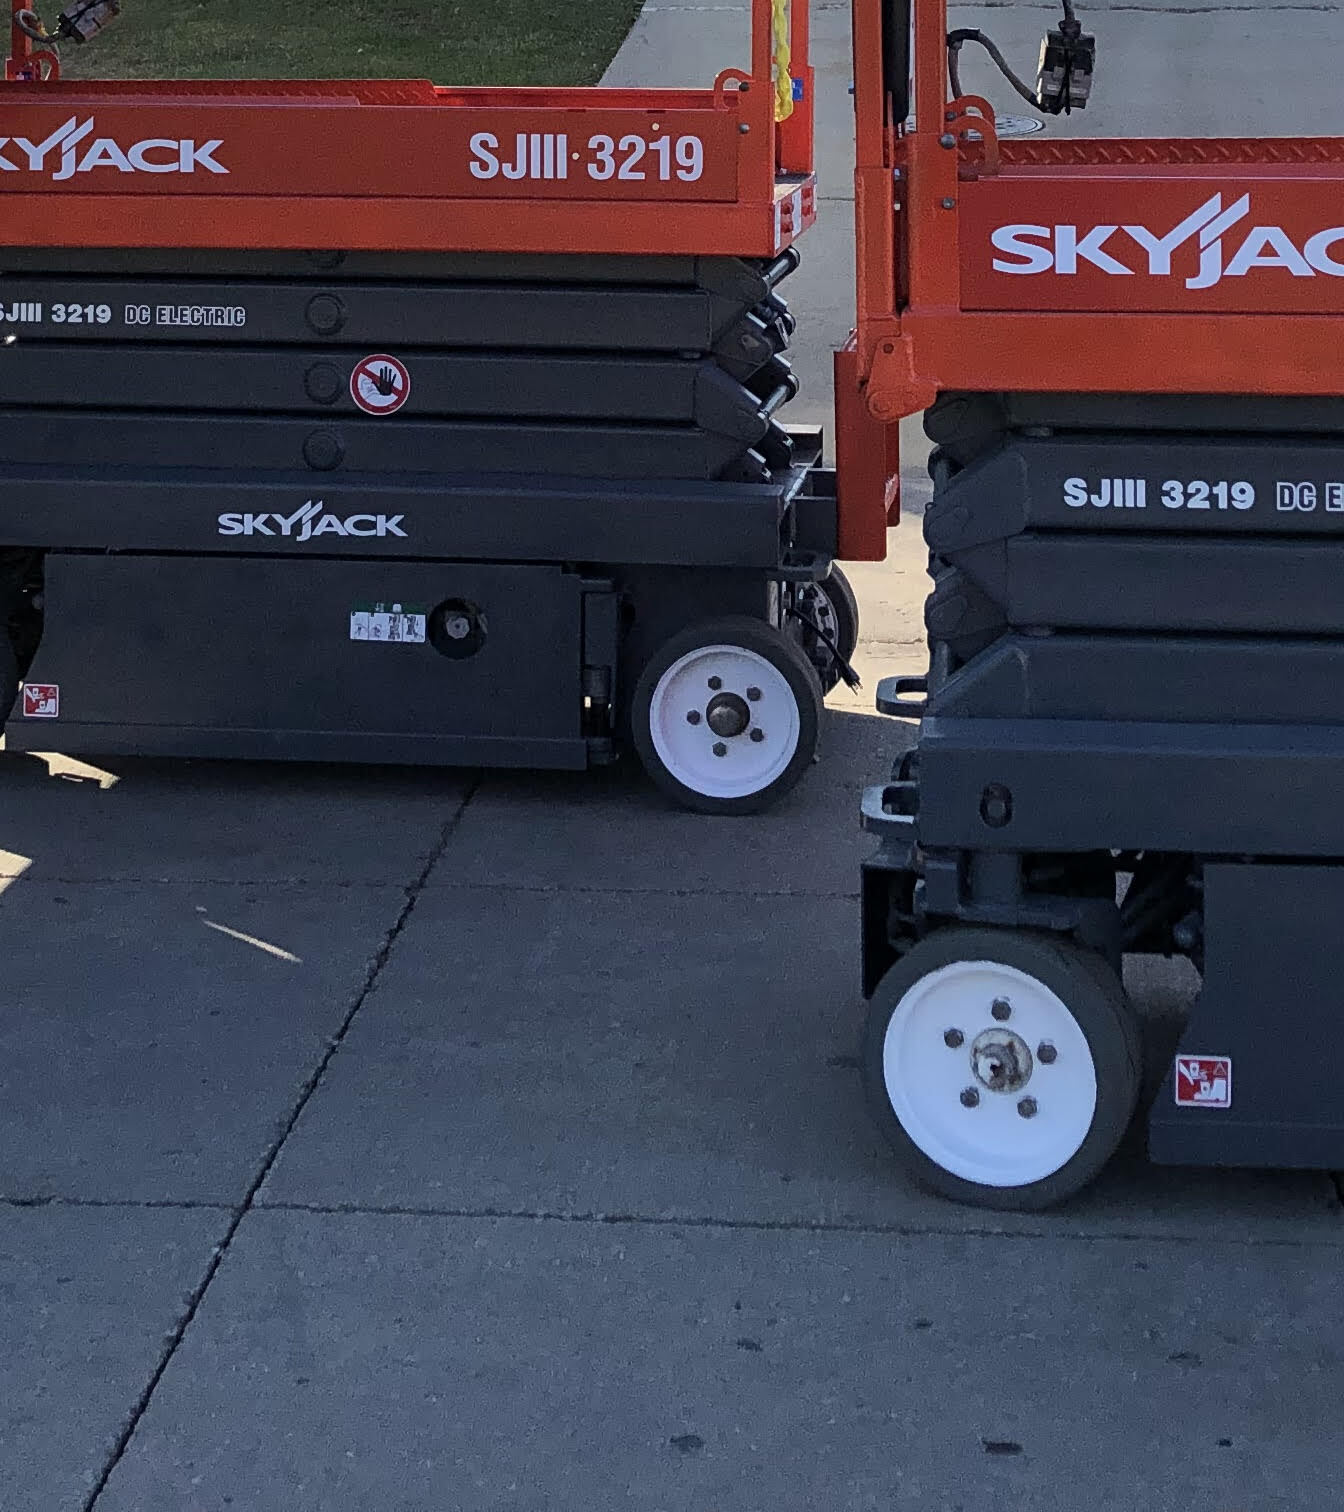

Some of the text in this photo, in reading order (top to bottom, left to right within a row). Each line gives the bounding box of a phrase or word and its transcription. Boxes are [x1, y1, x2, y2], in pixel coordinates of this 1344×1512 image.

[51, 303, 112, 324] 3219
[124, 304, 151, 325] DC
[155, 305, 246, 326] ELECTRIC
[1063, 477, 1146, 508] SJIII
[1161, 480, 1255, 510] 3219
[1276, 481, 1316, 512] DC
[217, 499, 409, 542] SKYJACK
